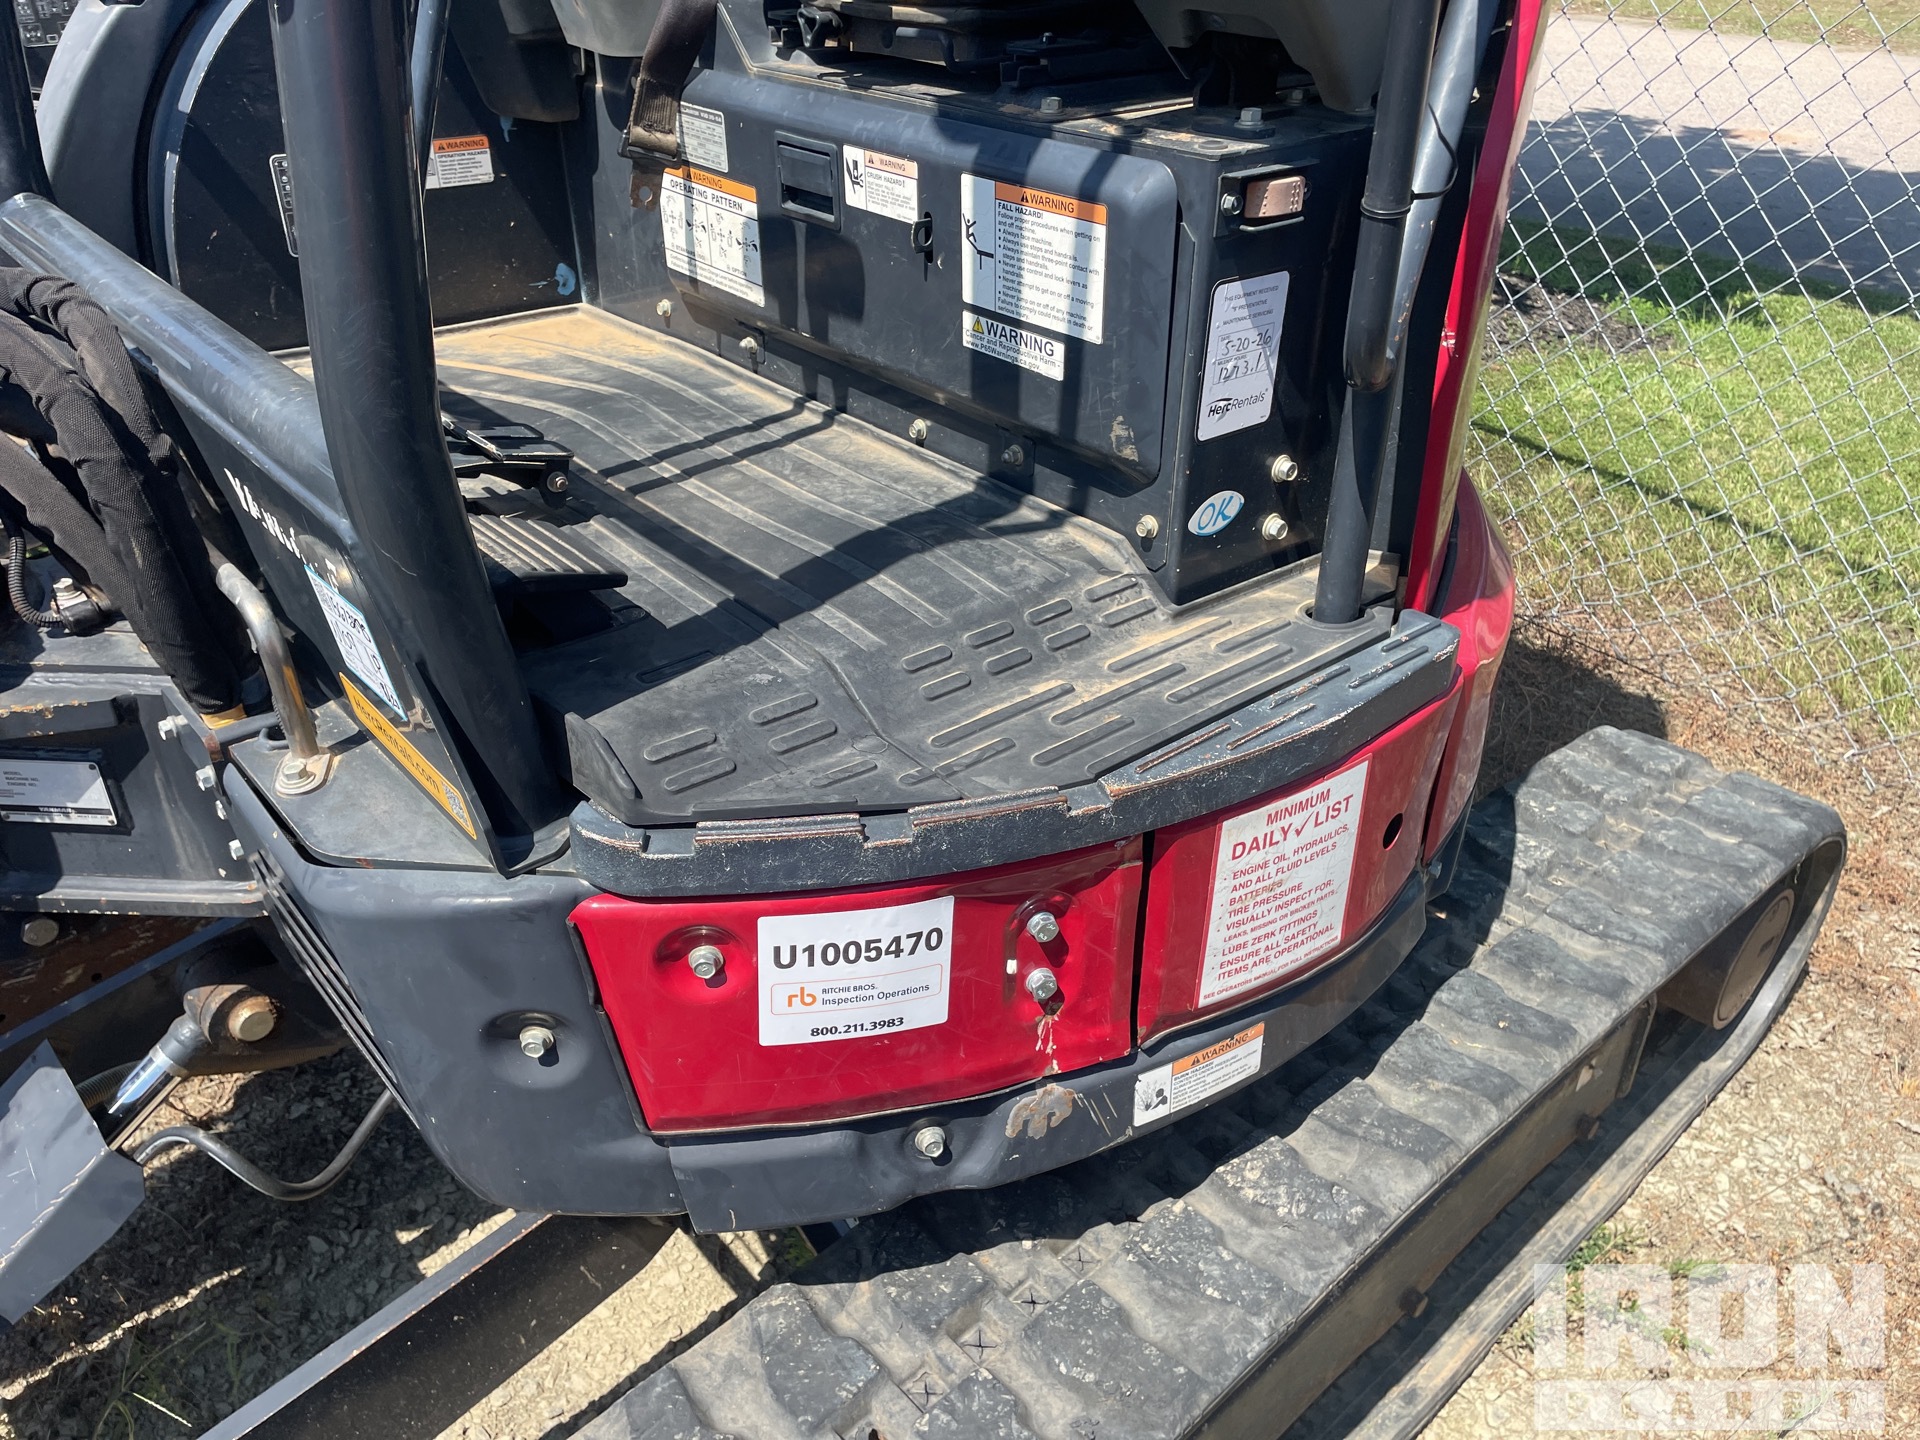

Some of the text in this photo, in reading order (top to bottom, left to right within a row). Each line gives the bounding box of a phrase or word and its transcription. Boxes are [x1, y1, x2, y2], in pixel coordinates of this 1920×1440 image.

[445, 139, 485, 149] WARNING
[879, 158, 906, 172] WARNING
[692, 172, 723, 189] WARNING
[867, 171, 905, 188] CRUSH HAZARD!
[670, 179, 743, 211] OPERATING PATTERN
[1029, 193, 1074, 213] WARNING
[997, 201, 1043, 218] FALL HAZARD!
[997, 211, 1013, 220] Follow
[1014, 216, 1029, 224] proper
[1030, 220, 1058, 232] procedures
[1059, 227, 1073, 235] when
[1074, 231, 1091, 242] getting
[997, 219, 1007, 227] and
[1014, 224, 1036, 234] machine.
[1002, 228, 1052, 247] Always face machine.
[1002, 236, 1019, 246] Always
[1029, 244, 1042, 252] steps
[1054, 250, 1078, 262] handrails.
[1002, 244, 1019, 254] Always
[1019, 249, 1040, 259] maintain
[1041, 254, 1067, 267] three-point
[1068, 263, 1087, 272] contact
[1002, 252, 1015, 261] steps
[1025, 258, 1049, 270] handrails.
[1002, 260, 1015, 268] Never
[1026, 267, 1043, 276] control
[1053, 274, 1064, 282] lock
[1065, 278, 1080, 287] levers
[1002, 275, 1015, 284] Never
[1016, 280, 1034, 290] attempt
[1075, 297, 1094, 309] moving
[1002, 290, 1015, 299] Never
[1016, 295, 1028, 304] jump
[1056, 307, 1065, 316] any
[1233, 289, 1257, 300] EQUIPMENT
[1257, 285, 1279, 294] RECEIVED
[1237, 298, 1267, 310] PREVENTATIVE
[997, 297, 1013, 306] Failure
[1019, 304, 1036, 315] comply
[1037, 310, 1051, 318] could
[1051, 314, 1065, 323] result
[1072, 320, 1086, 328] death
[997, 305, 1029, 320] serious injury.
[1222, 308, 1273, 325] MAINTENANCE SERVICING
[965, 329, 1056, 367] Cancer and Reproductive Harm
[985, 321, 1053, 356] WARNING
[1221, 329, 1271, 356] 5-20-26
[966, 340, 1039, 369] www.P65Warnings.ca.gov.
[1198, 495, 1234, 531] OK
[353, 694, 440, 793] HercRentals.com
[1266, 788, 1330, 825] MINIMUM
[1231, 794, 1353, 860] DAILY LIST
[1232, 824, 1348, 880] ENGINE OIL, HYDRAULICS,
[1230, 841, 1336, 893] AND ALL FLUID LEVELS
[1226, 879, 1334, 930] VISUALLY INSPECT FOR:
[1227, 882, 1302, 918] TIRE PRESSURE
[1229, 879, 1283, 906] BATTERIES
[1221, 909, 1317, 956] LUBE ZERK FITTINGS
[1223, 929, 1248, 942] LEAKS,
[1250, 917, 1277, 932] MISSING
[1278, 912, 1288, 921] OR
[1289, 899, 1315, 916] BROKEN
[773, 927, 944, 969] U1005470
[1217, 923, 1333, 980] ITEMS ARE OPERATIONAL
[1219, 921, 1317, 969] ENSURE ALL SAFETY
[1202, 991, 1215, 1000] SEE
[1216, 978, 1252, 995] OPERATORS
[1276, 961, 1288, 971] FOR
[1289, 955, 1302, 965] FULL
[1303, 935, 1338, 957] INSTRUCTIONS
[787, 986, 817, 1008] rb
[822, 983, 878, 995] RITCHIE BROS.
[822, 984, 930, 1006] Inspection Operations
[810, 1017, 904, 1037] 800.211.3983
[1201, 1033, 1248, 1060] WARNING
[1173, 1053, 1238, 1086] CONTENTS UNDER PRESSURE!
[1173, 1060, 1214, 1081] BURN HAZARD!
